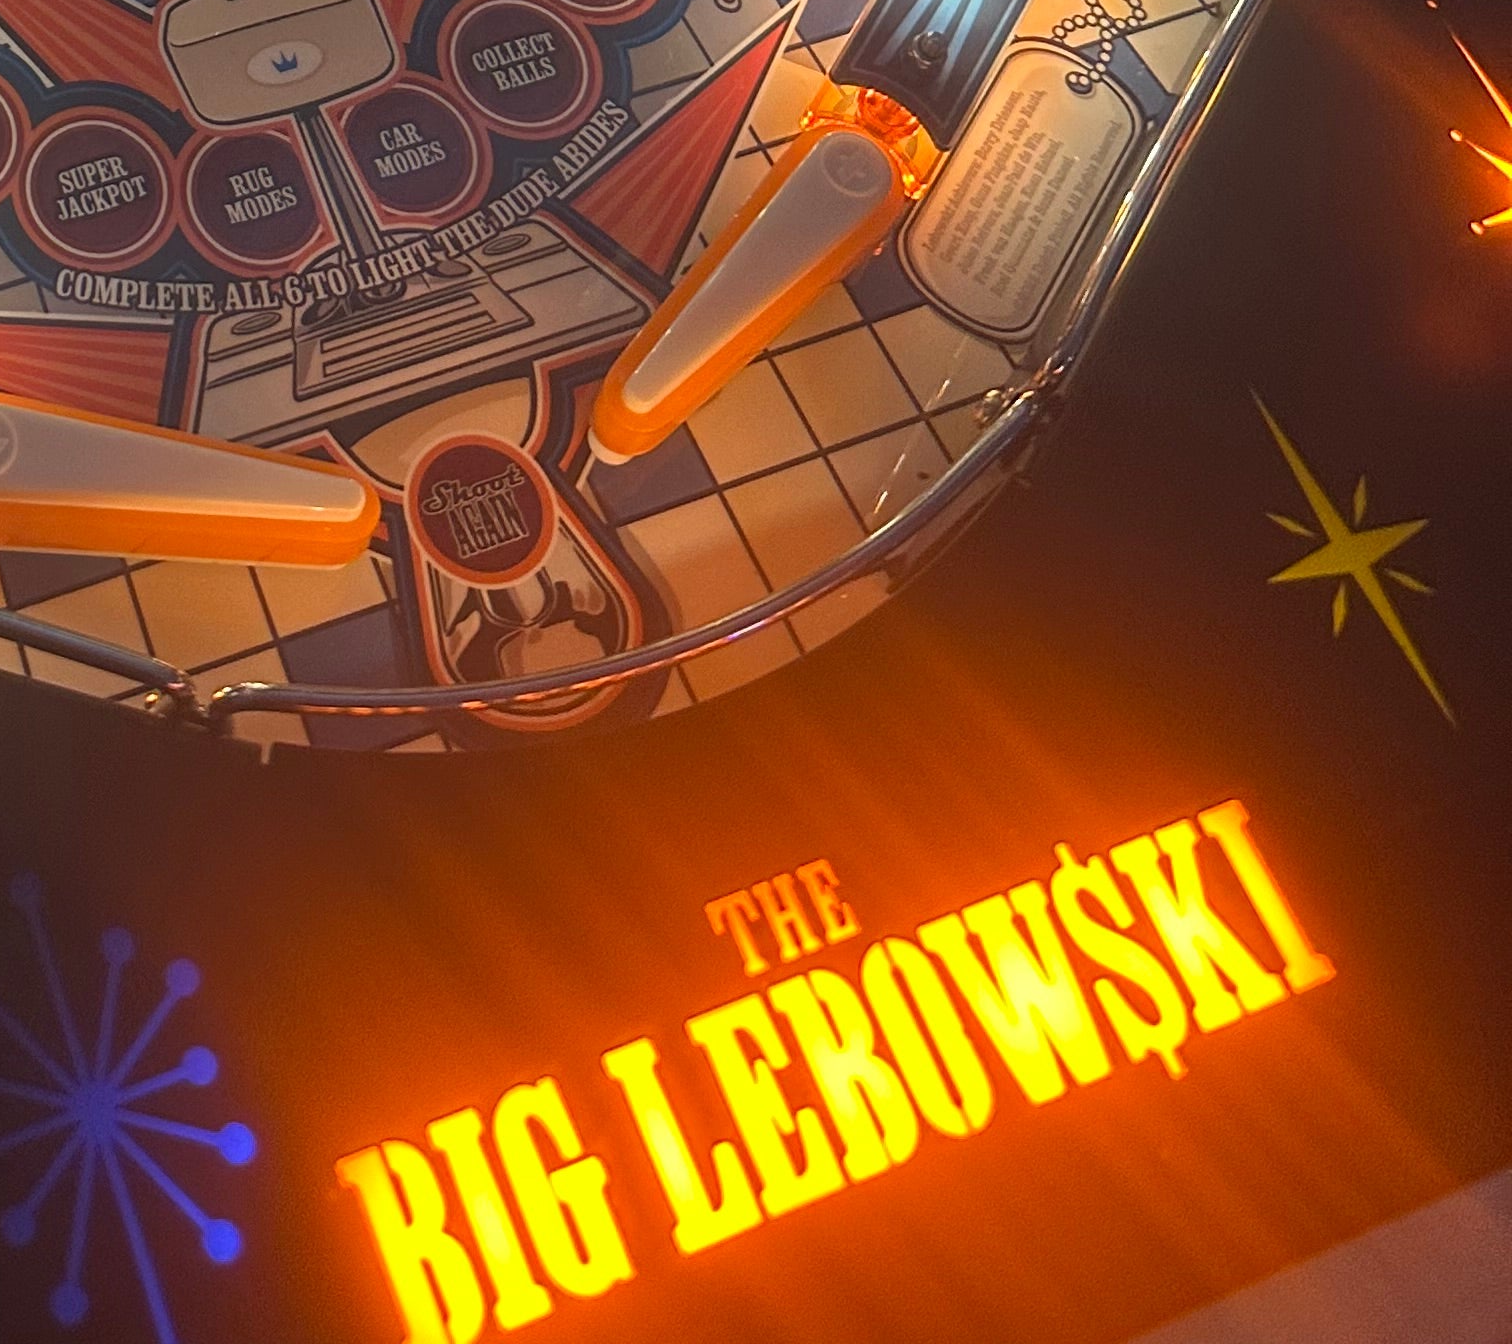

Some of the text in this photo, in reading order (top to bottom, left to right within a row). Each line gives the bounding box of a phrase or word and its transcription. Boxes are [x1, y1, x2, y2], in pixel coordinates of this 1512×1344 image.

[472, 31, 555, 73] COLLECT
[492, 58, 557, 92] BALLS
[380, 122, 423, 152] CAR
[58, 156, 128, 194] SUPER
[374, 141, 446, 178] MODES
[57, 176, 148, 220] JACKPOT
[229, 166, 274, 198] RUG
[55, 99, 630, 312] COMPLETE ALL 6 TO LIGHT THE DUDE ABIDES
[224, 186, 298, 225] MODES
[422, 463, 525, 515] Shoot
[447, 488, 529, 559] AGAIN
[704, 857, 862, 978] THE
[333, 797, 1338, 1344] BIG LEBOW$KI
